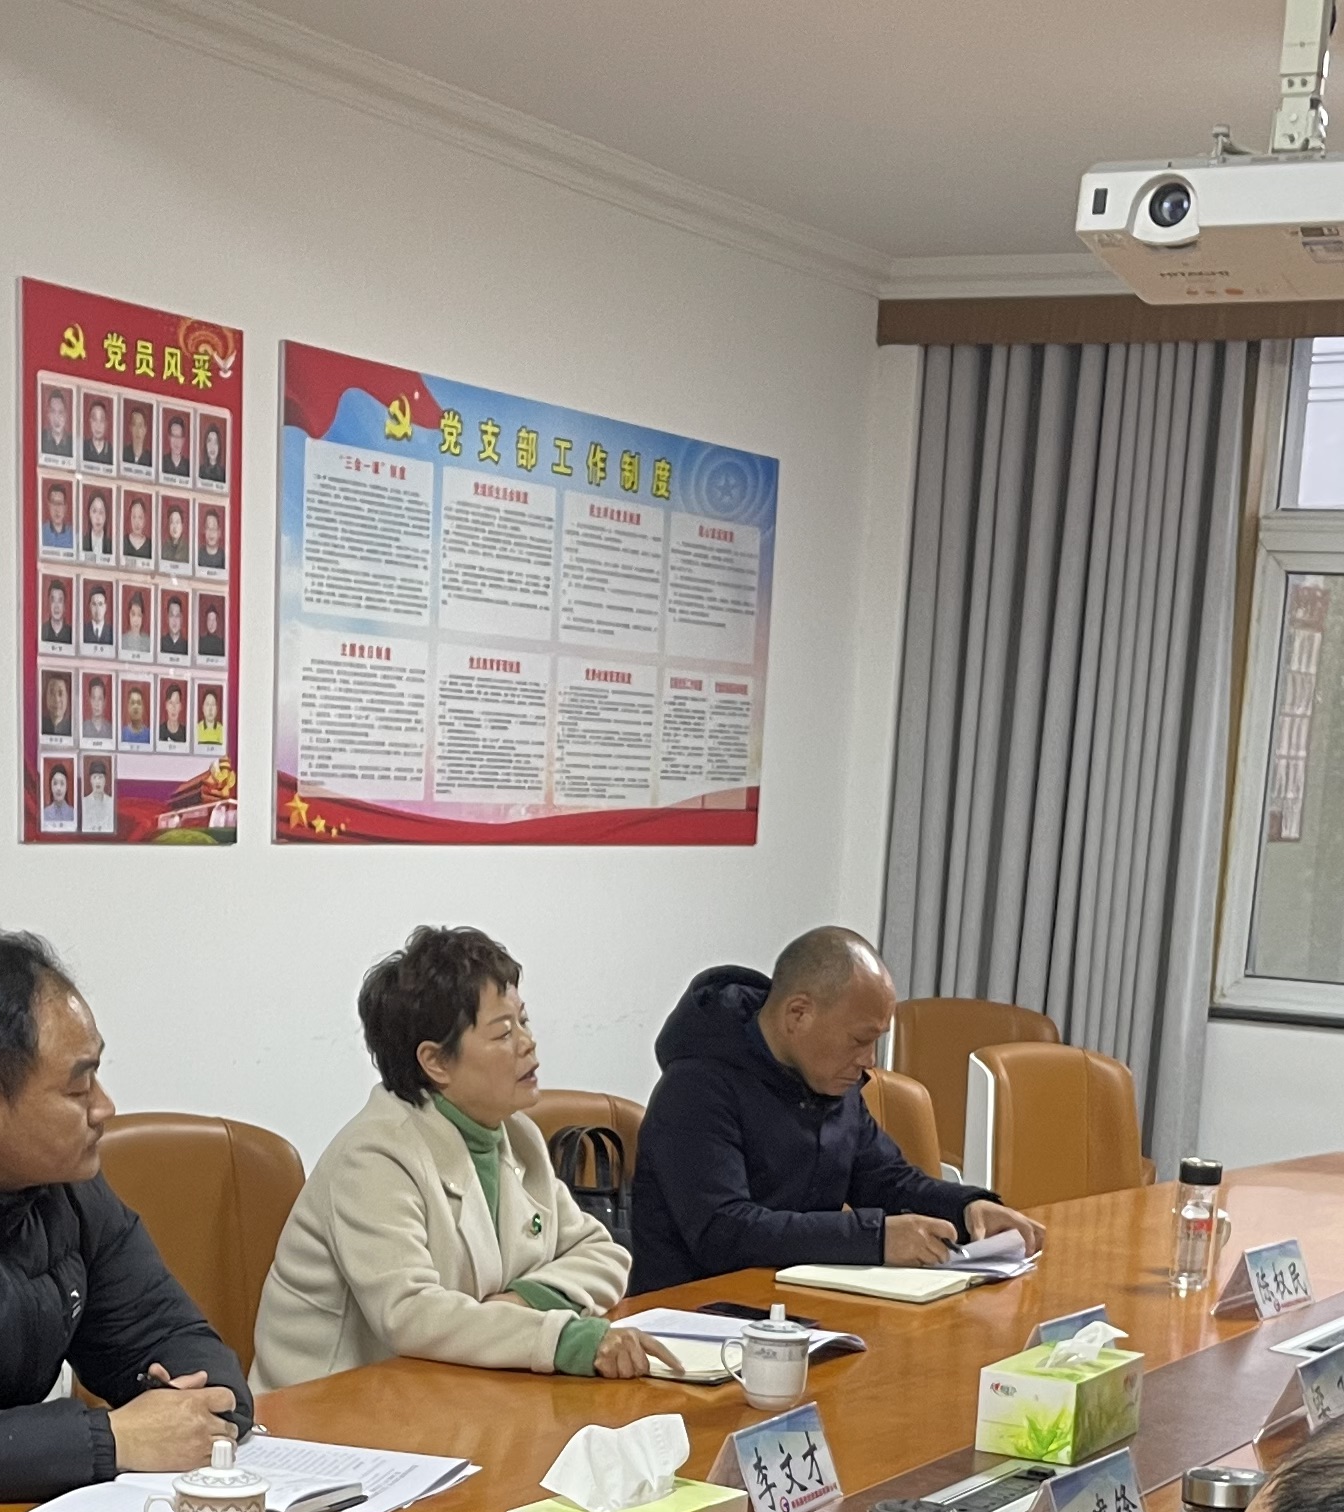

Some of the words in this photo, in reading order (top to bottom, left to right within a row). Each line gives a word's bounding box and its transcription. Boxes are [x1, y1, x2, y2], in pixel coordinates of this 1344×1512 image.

[103, 332, 213, 389] 党员风采
[439, 409, 673, 499] 党支部工作制度
[753, 1431, 824, 1511] 李文才
